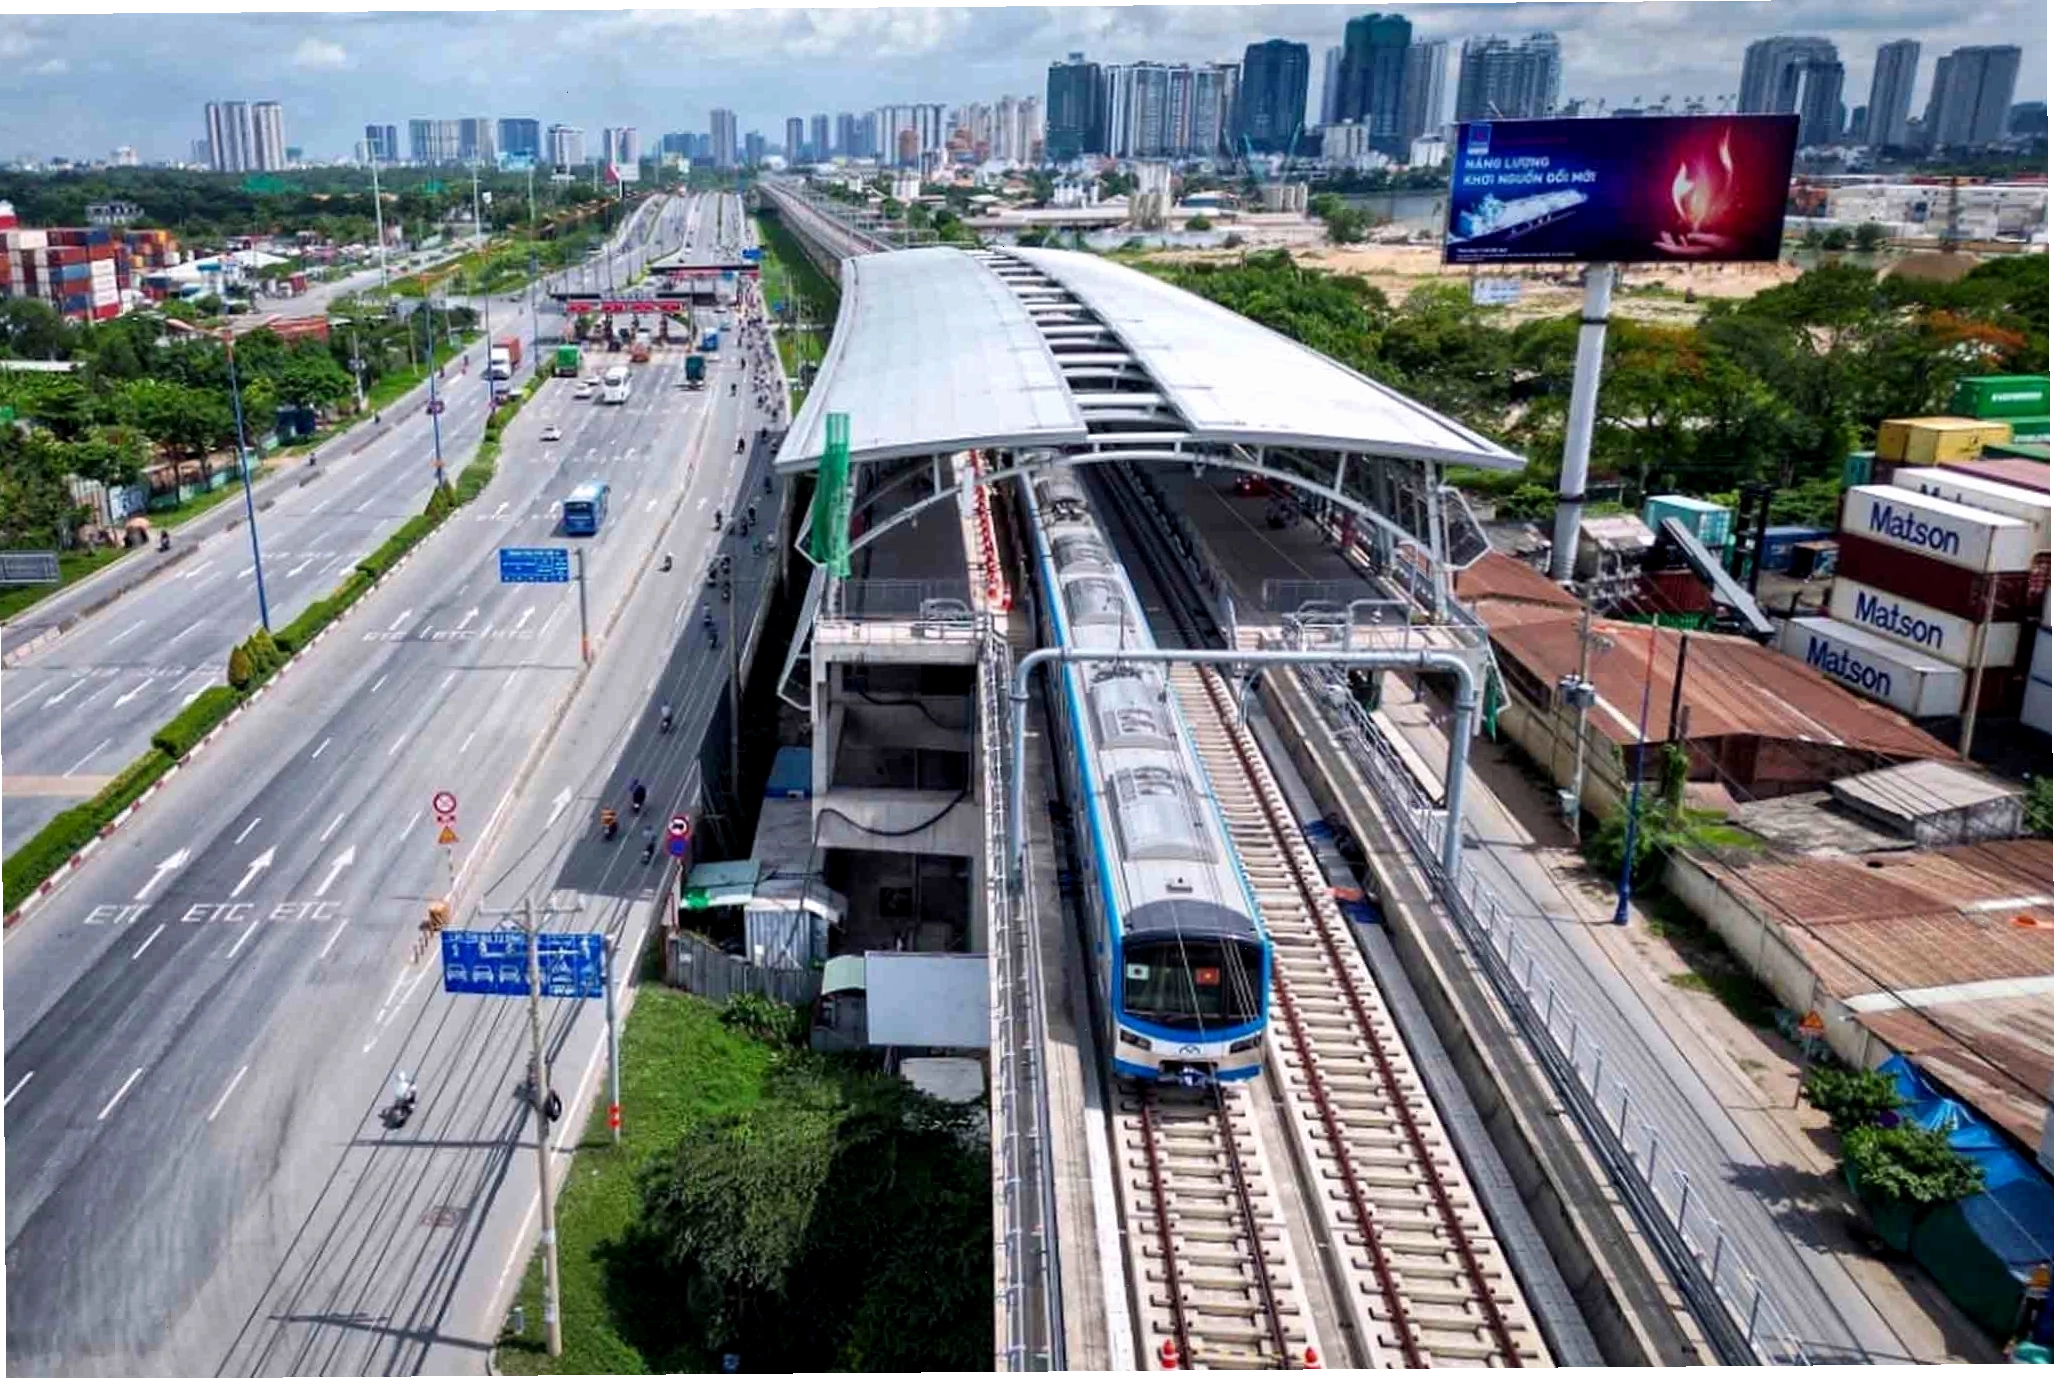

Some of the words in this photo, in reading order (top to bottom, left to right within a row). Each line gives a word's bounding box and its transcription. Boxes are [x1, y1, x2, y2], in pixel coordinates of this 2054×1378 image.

[1870, 501, 1960, 556] Matson
[1854, 590, 1944, 650] Matson
[1807, 635, 1893, 697] Matson
[180, 903, 255, 923] ETC
[268, 901, 341, 921] ETC
